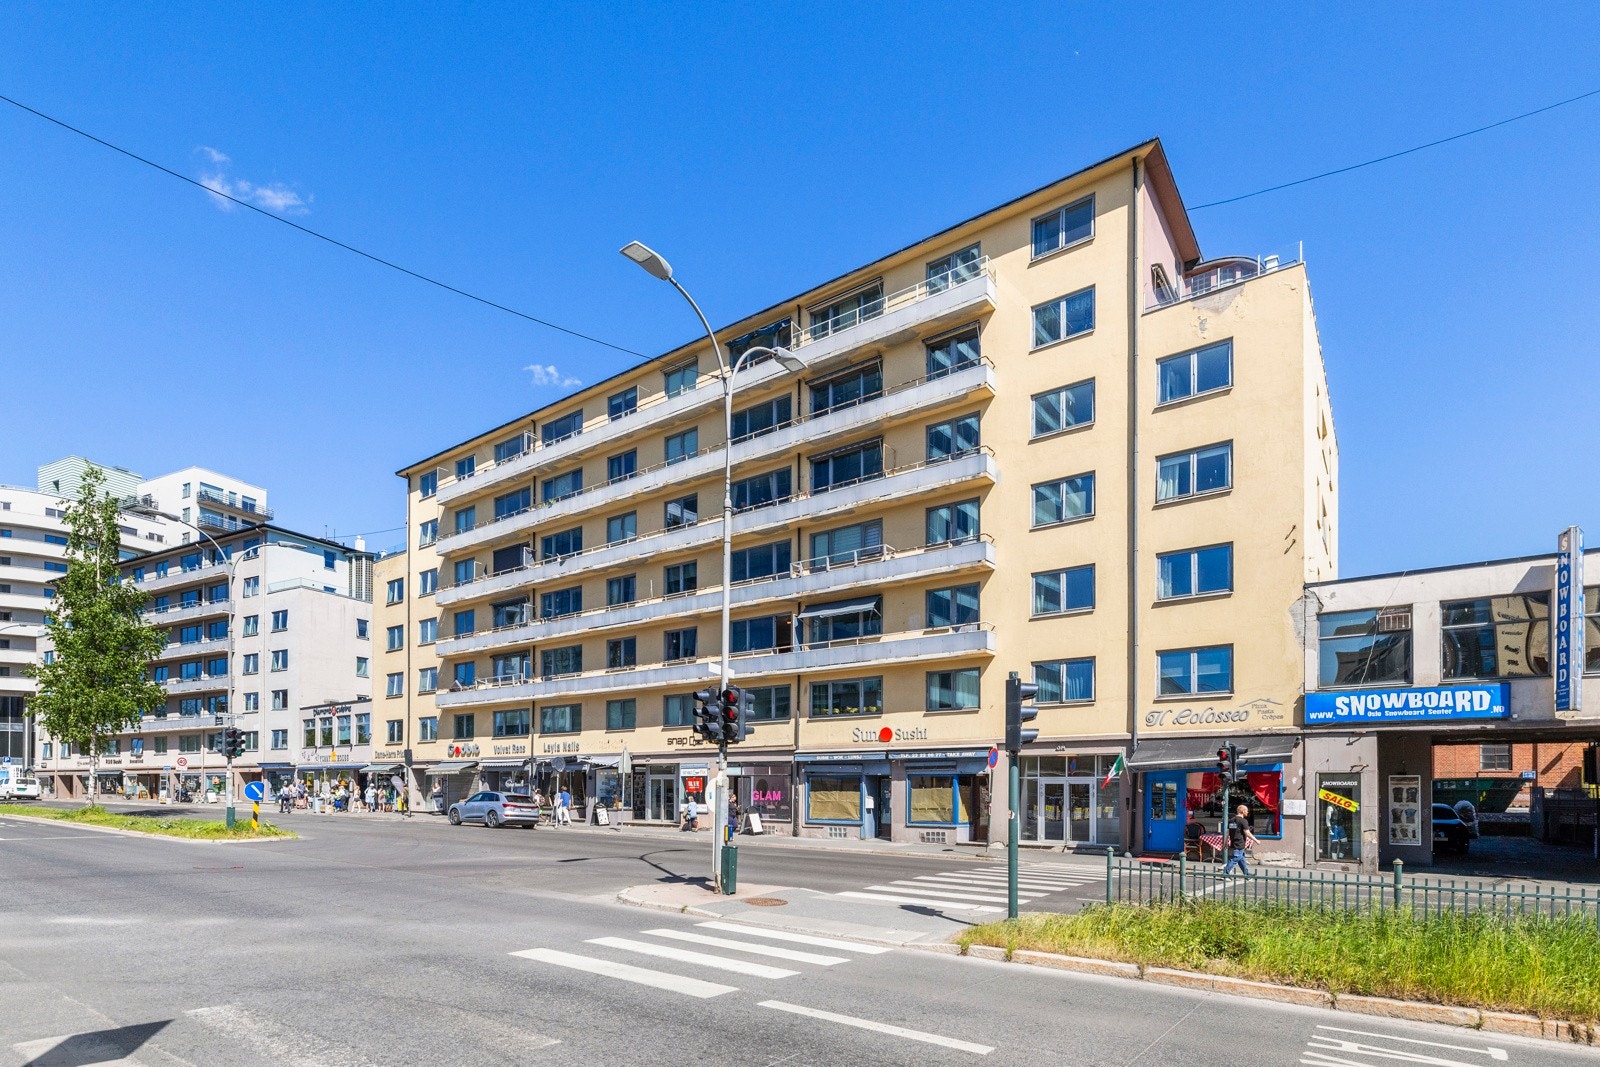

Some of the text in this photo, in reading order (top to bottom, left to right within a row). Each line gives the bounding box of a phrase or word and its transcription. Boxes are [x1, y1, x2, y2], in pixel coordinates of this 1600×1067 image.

[1558, 537, 1570, 683] SNOWBOARD
[1172, 706, 1250, 725] Colosseo
[1385, 709, 1425, 717] Snowboard
[852, 727, 928, 742] Sun Sushi
[563, 741, 580, 753] Nails
[667, 737, 688, 746] snap
[752, 790, 781, 801] GLAM
[1323, 792, 1352, 808] SALG
